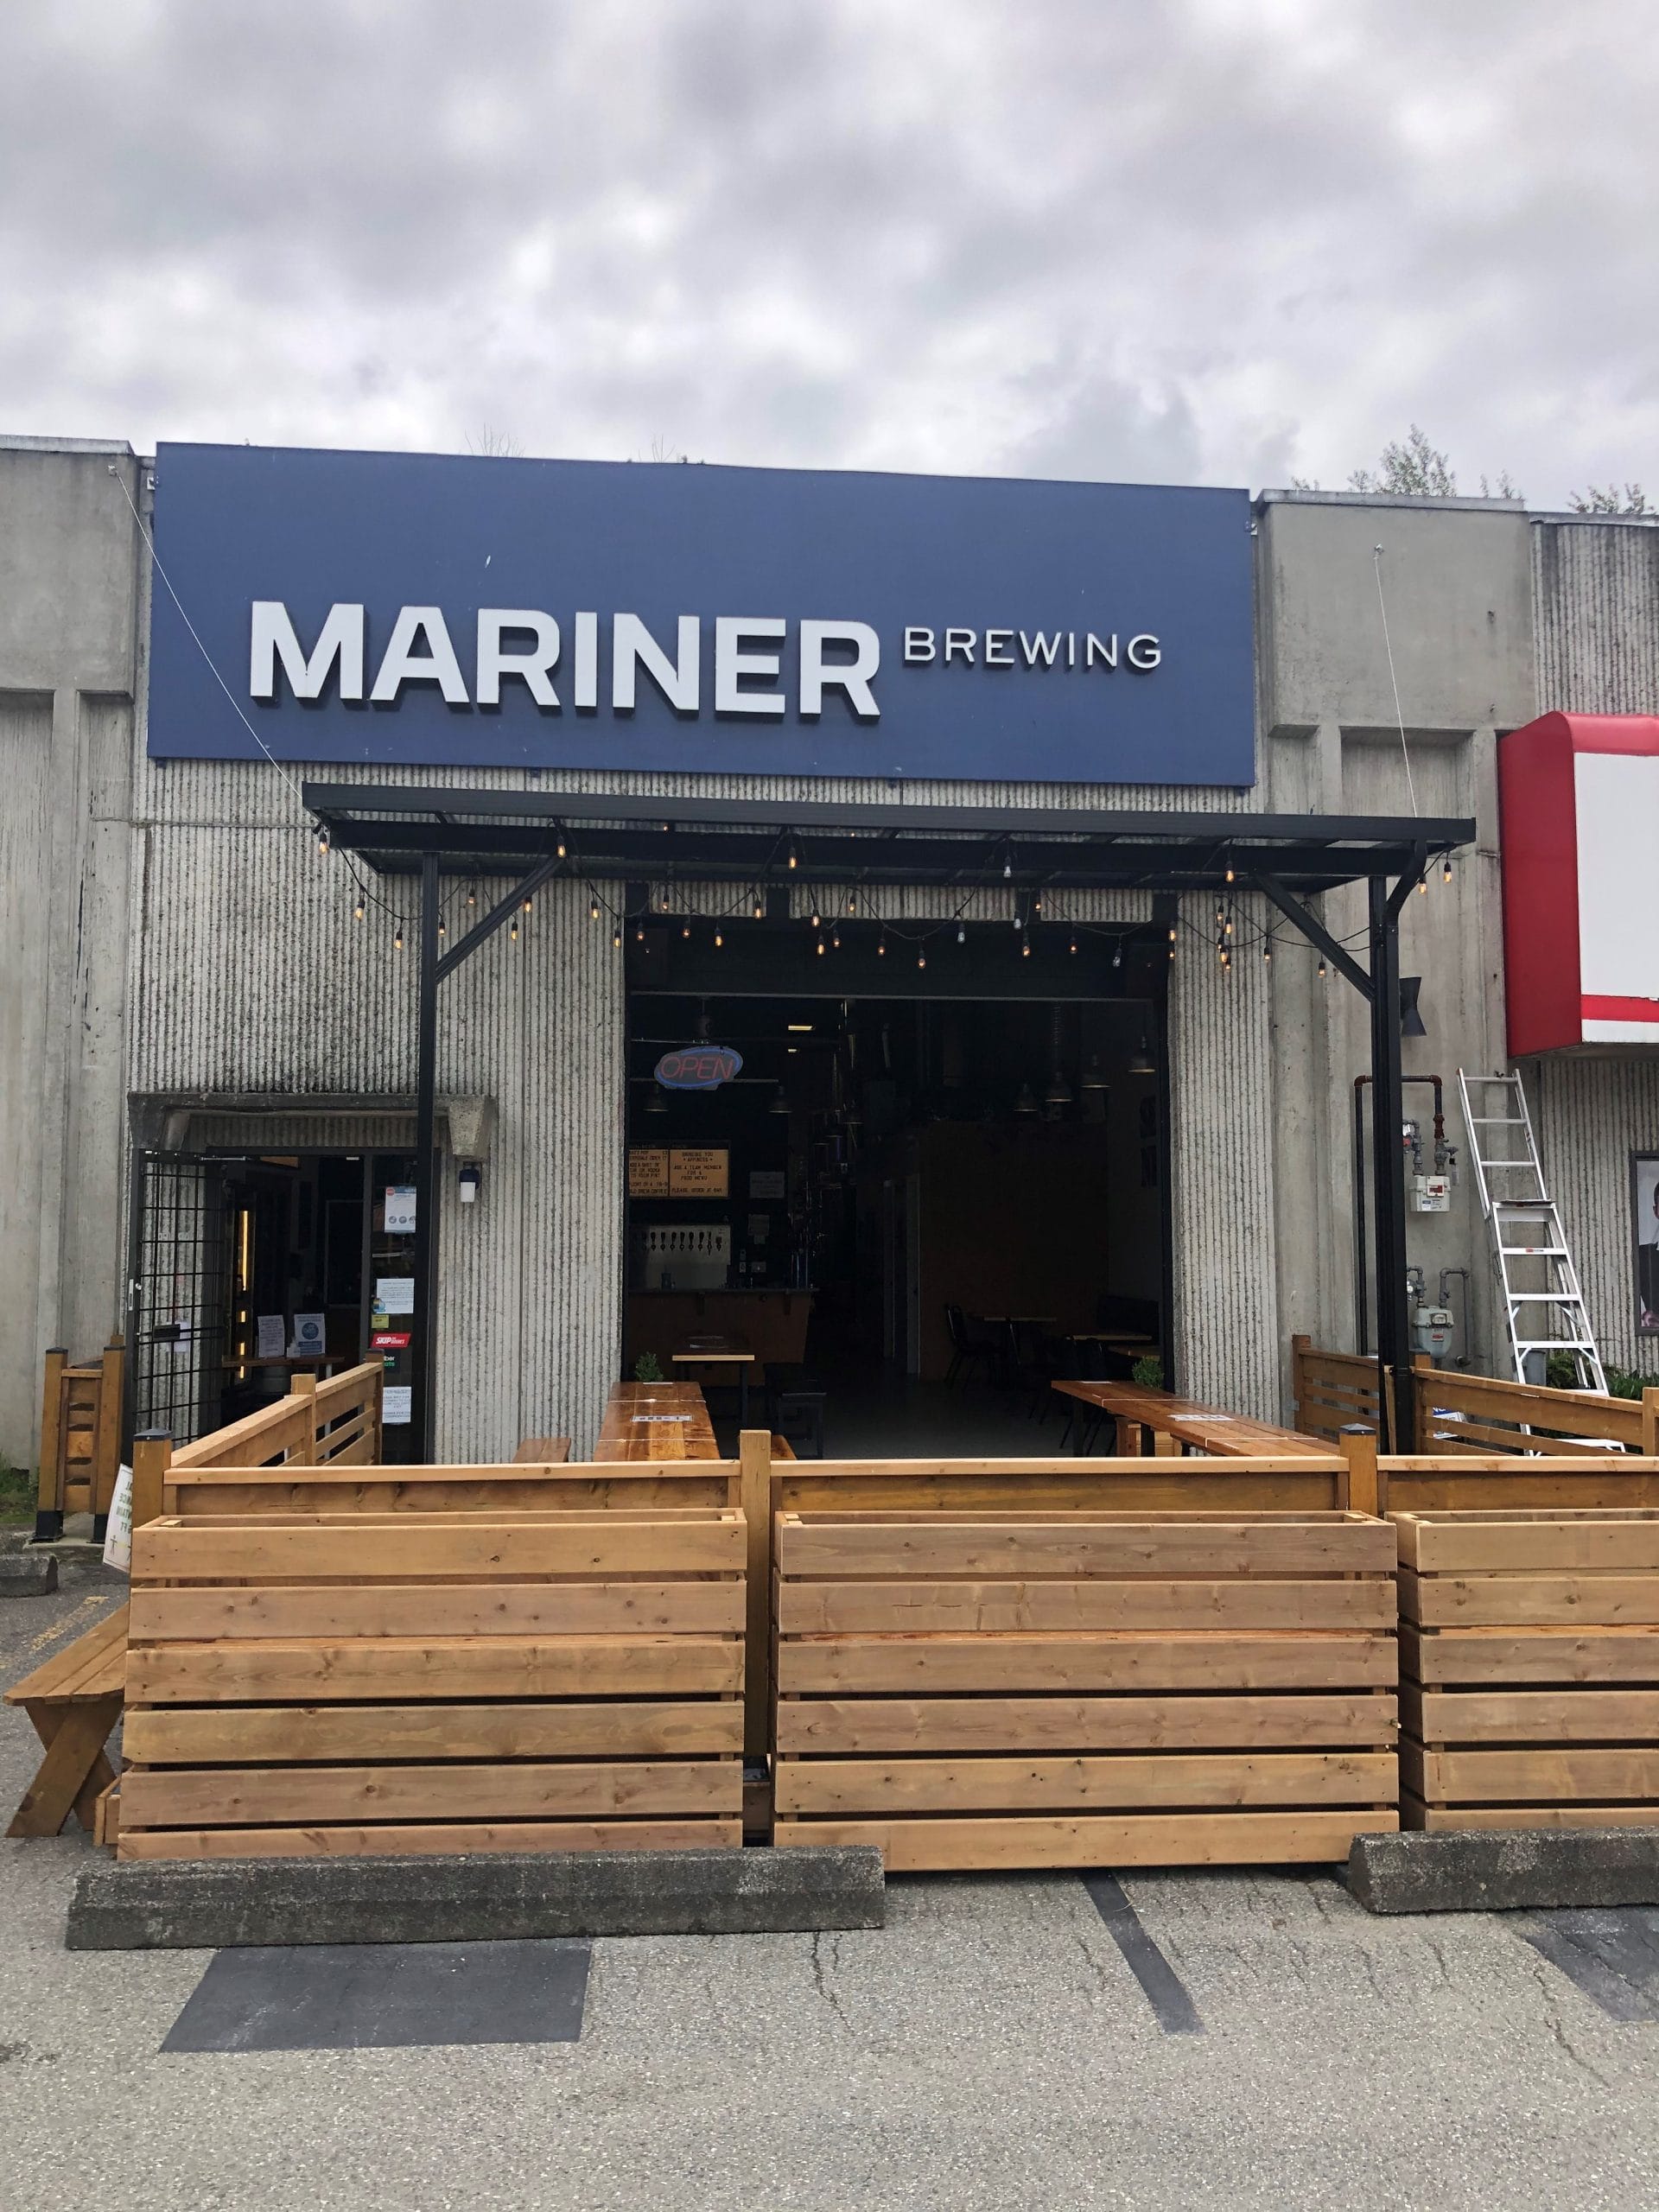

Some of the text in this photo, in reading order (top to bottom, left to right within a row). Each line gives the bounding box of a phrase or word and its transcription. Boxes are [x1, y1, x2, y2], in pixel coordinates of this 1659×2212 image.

[250, 600, 1162, 716] MARINER BREWING
[660, 1056, 734, 1080] OPEN
